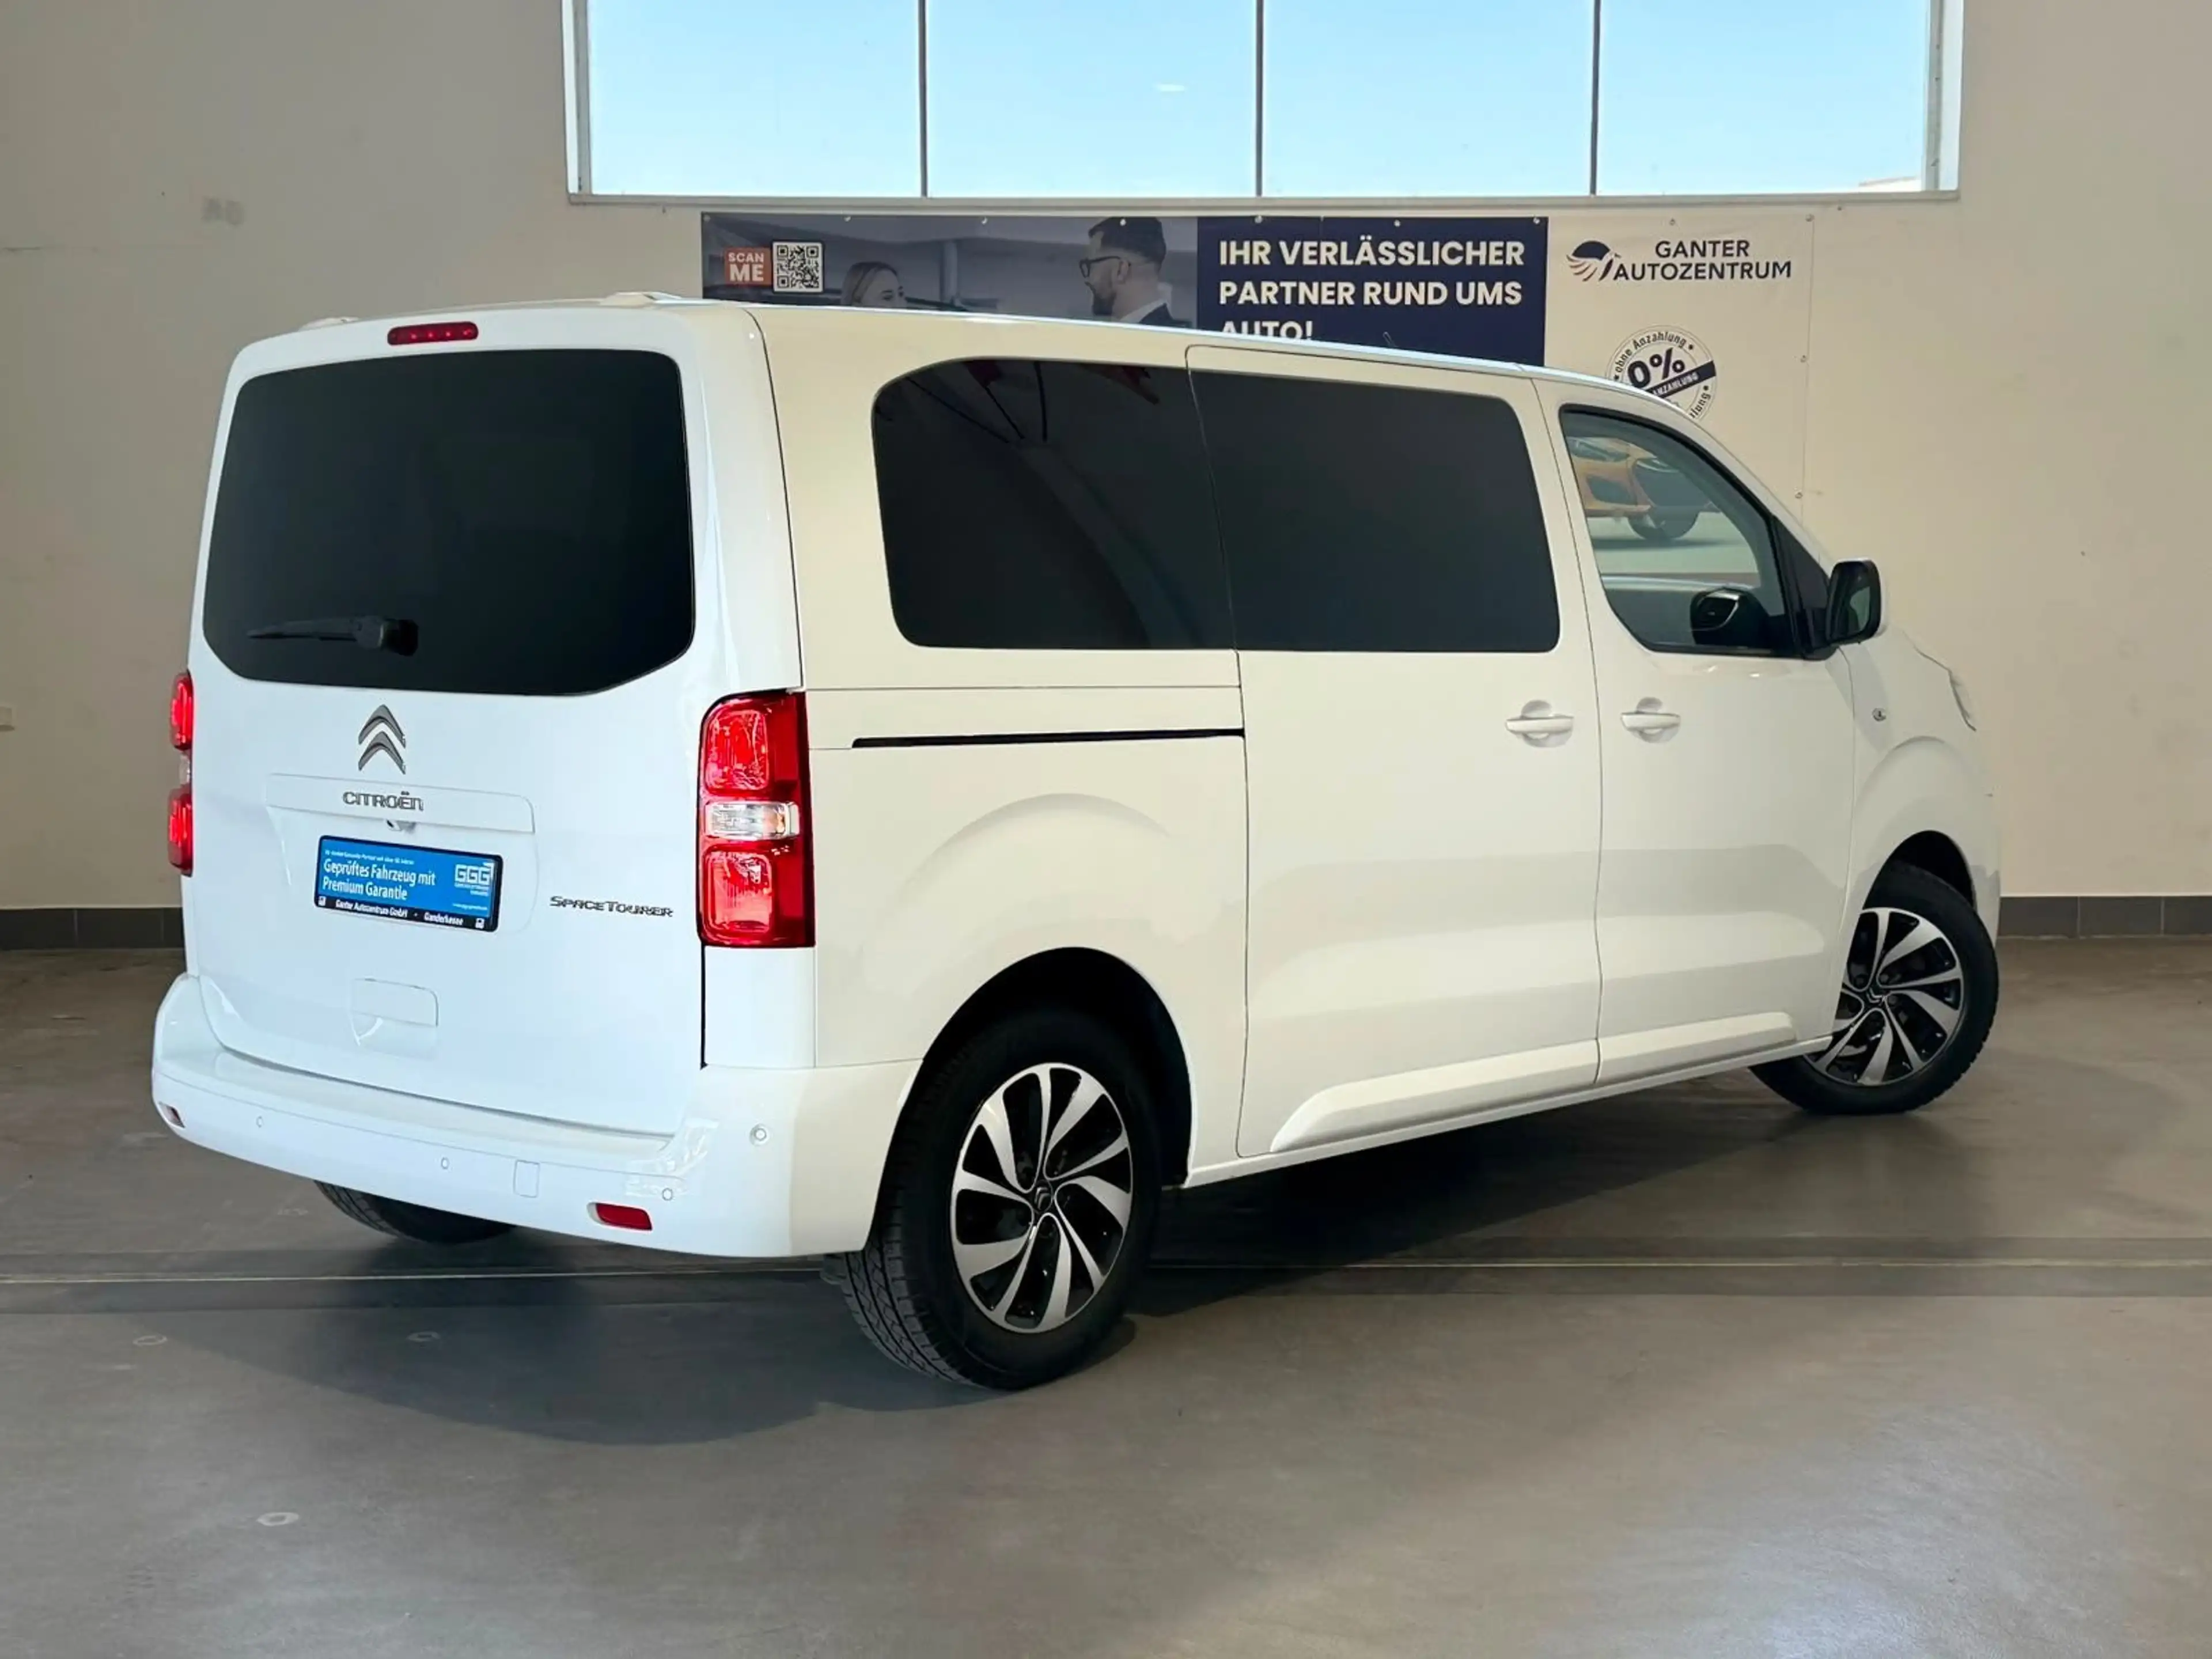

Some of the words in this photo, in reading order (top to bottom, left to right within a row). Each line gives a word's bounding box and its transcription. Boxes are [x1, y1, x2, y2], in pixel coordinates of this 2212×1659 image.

[728, 252, 764, 263] SCAN
[1219, 241, 1271, 266] IHR
[1279, 234, 1525, 266] VERLÄSSLICHER
[1655, 239, 1750, 258] GANTER
[729, 264, 764, 282] ME
[1613, 261, 1791, 281] AUTOZENTRUM
[1219, 281, 1355, 305] PARTNER
[1363, 281, 1448, 305] RUND
[1456, 281, 1522, 305] UMS
[1615, 349, 1633, 373] ohne
[1633, 332, 1687, 349] Anzahlung
[1627, 347, 1685, 389] 0%
[324, 859, 369, 878] Geprüftes
[371, 864, 416, 887] Fahrzeug
[418, 871, 435, 885] mit
[454, 864, 492, 885] GGG
[323, 876, 364, 893] Premium
[365, 882, 408, 900] Garantie
